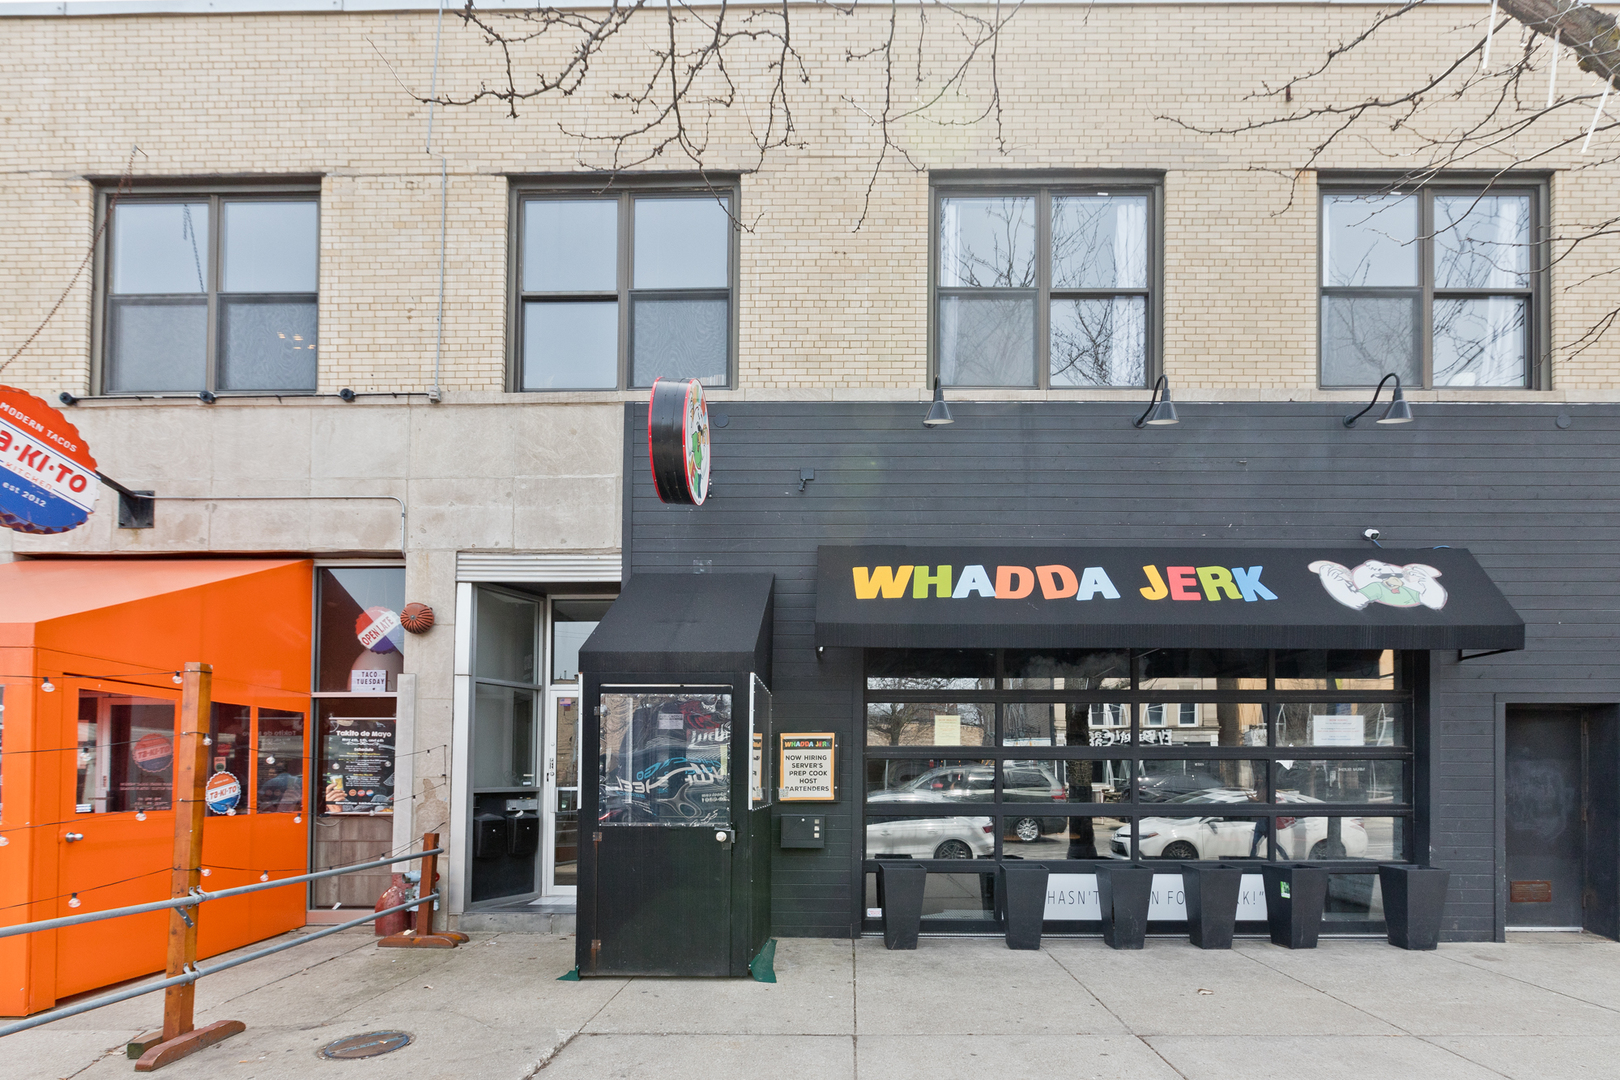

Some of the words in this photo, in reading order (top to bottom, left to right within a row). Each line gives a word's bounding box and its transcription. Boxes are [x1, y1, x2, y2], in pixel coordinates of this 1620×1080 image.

[0, 402, 44, 432] MODERN
[45, 428, 77, 453] TACOS
[2, 480, 21, 494] est
[21, 491, 47, 507] 2012
[852, 564, 1120, 602] WHADDA
[1138, 563, 1279, 603] JERK
[361, 628, 380, 646] OPEN
[376, 615, 394, 633] LATE
[371, 731, 391, 739] Mayo
[1047, 890, 1099, 905] HASN'T
